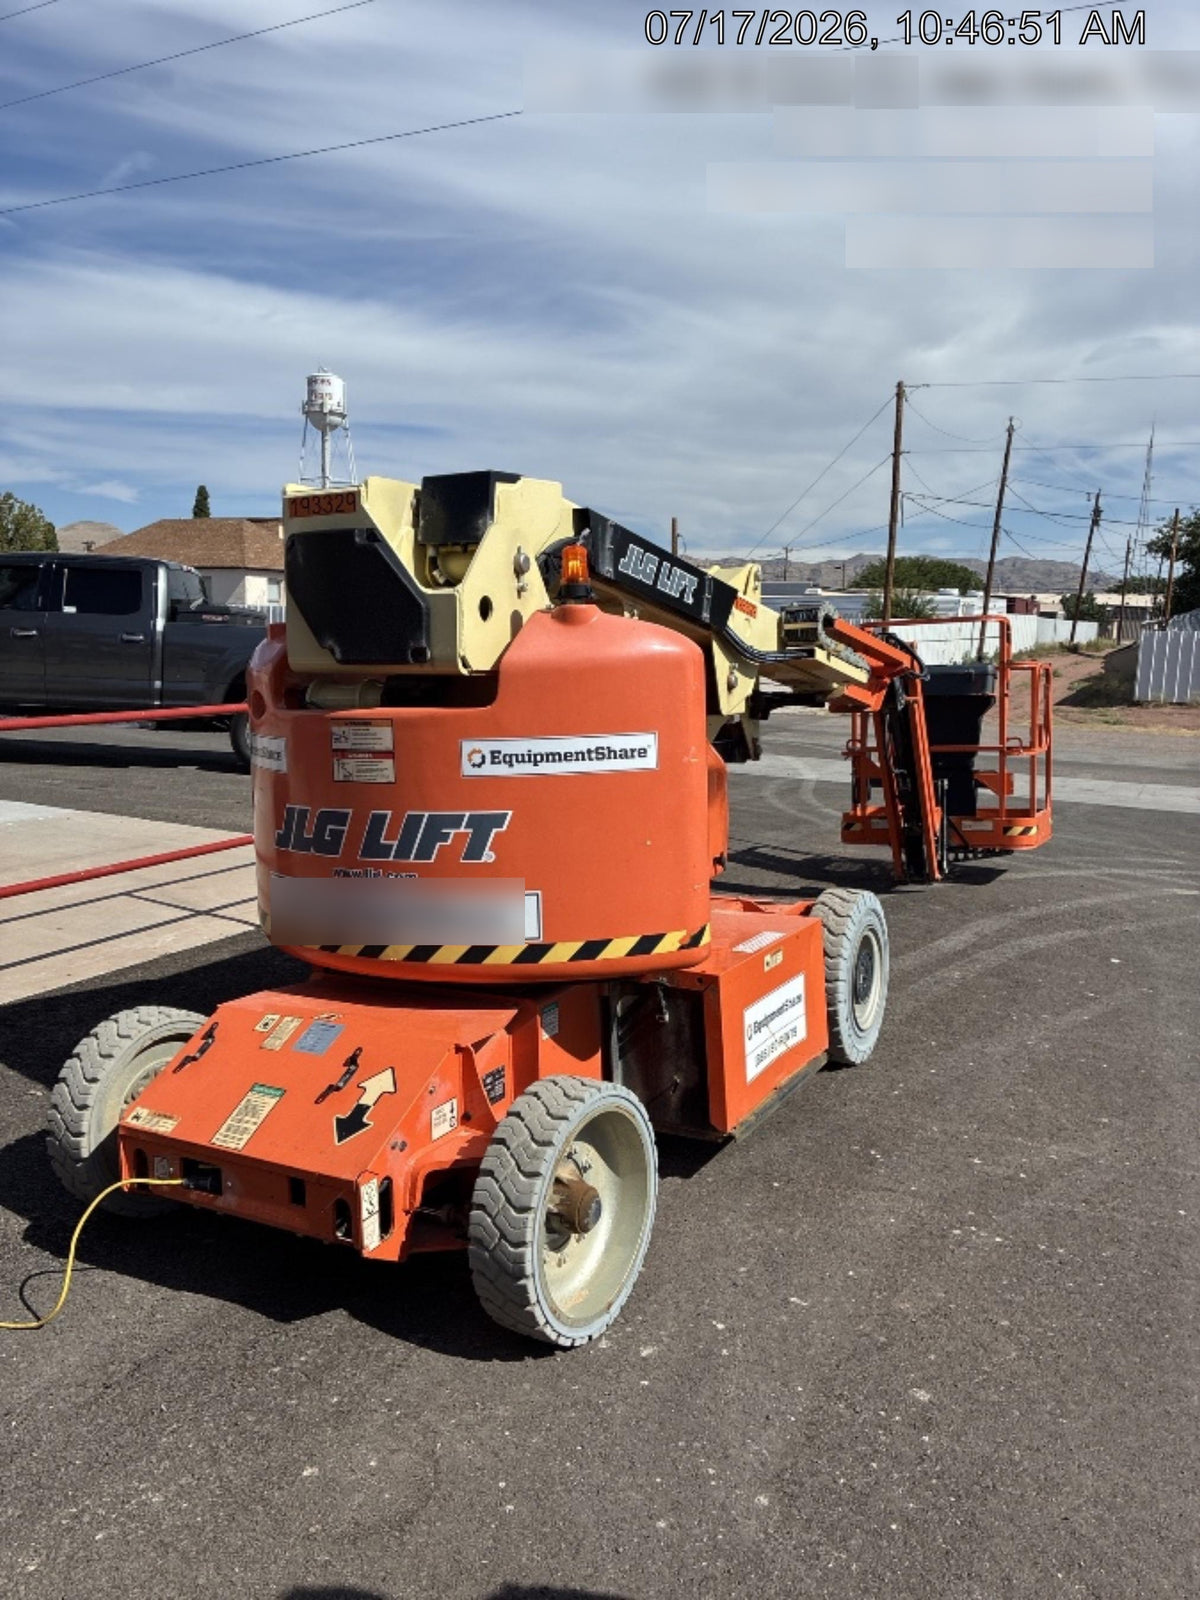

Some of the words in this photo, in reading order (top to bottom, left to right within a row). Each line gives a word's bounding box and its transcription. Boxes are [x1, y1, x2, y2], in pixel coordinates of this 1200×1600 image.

[618, 544, 659, 585] JLG
[658, 562, 698, 604] LIFT
[489, 744, 649, 767] EquipmentShare
[275, 804, 353, 857] JLG
[357, 810, 513, 863] LIFT
